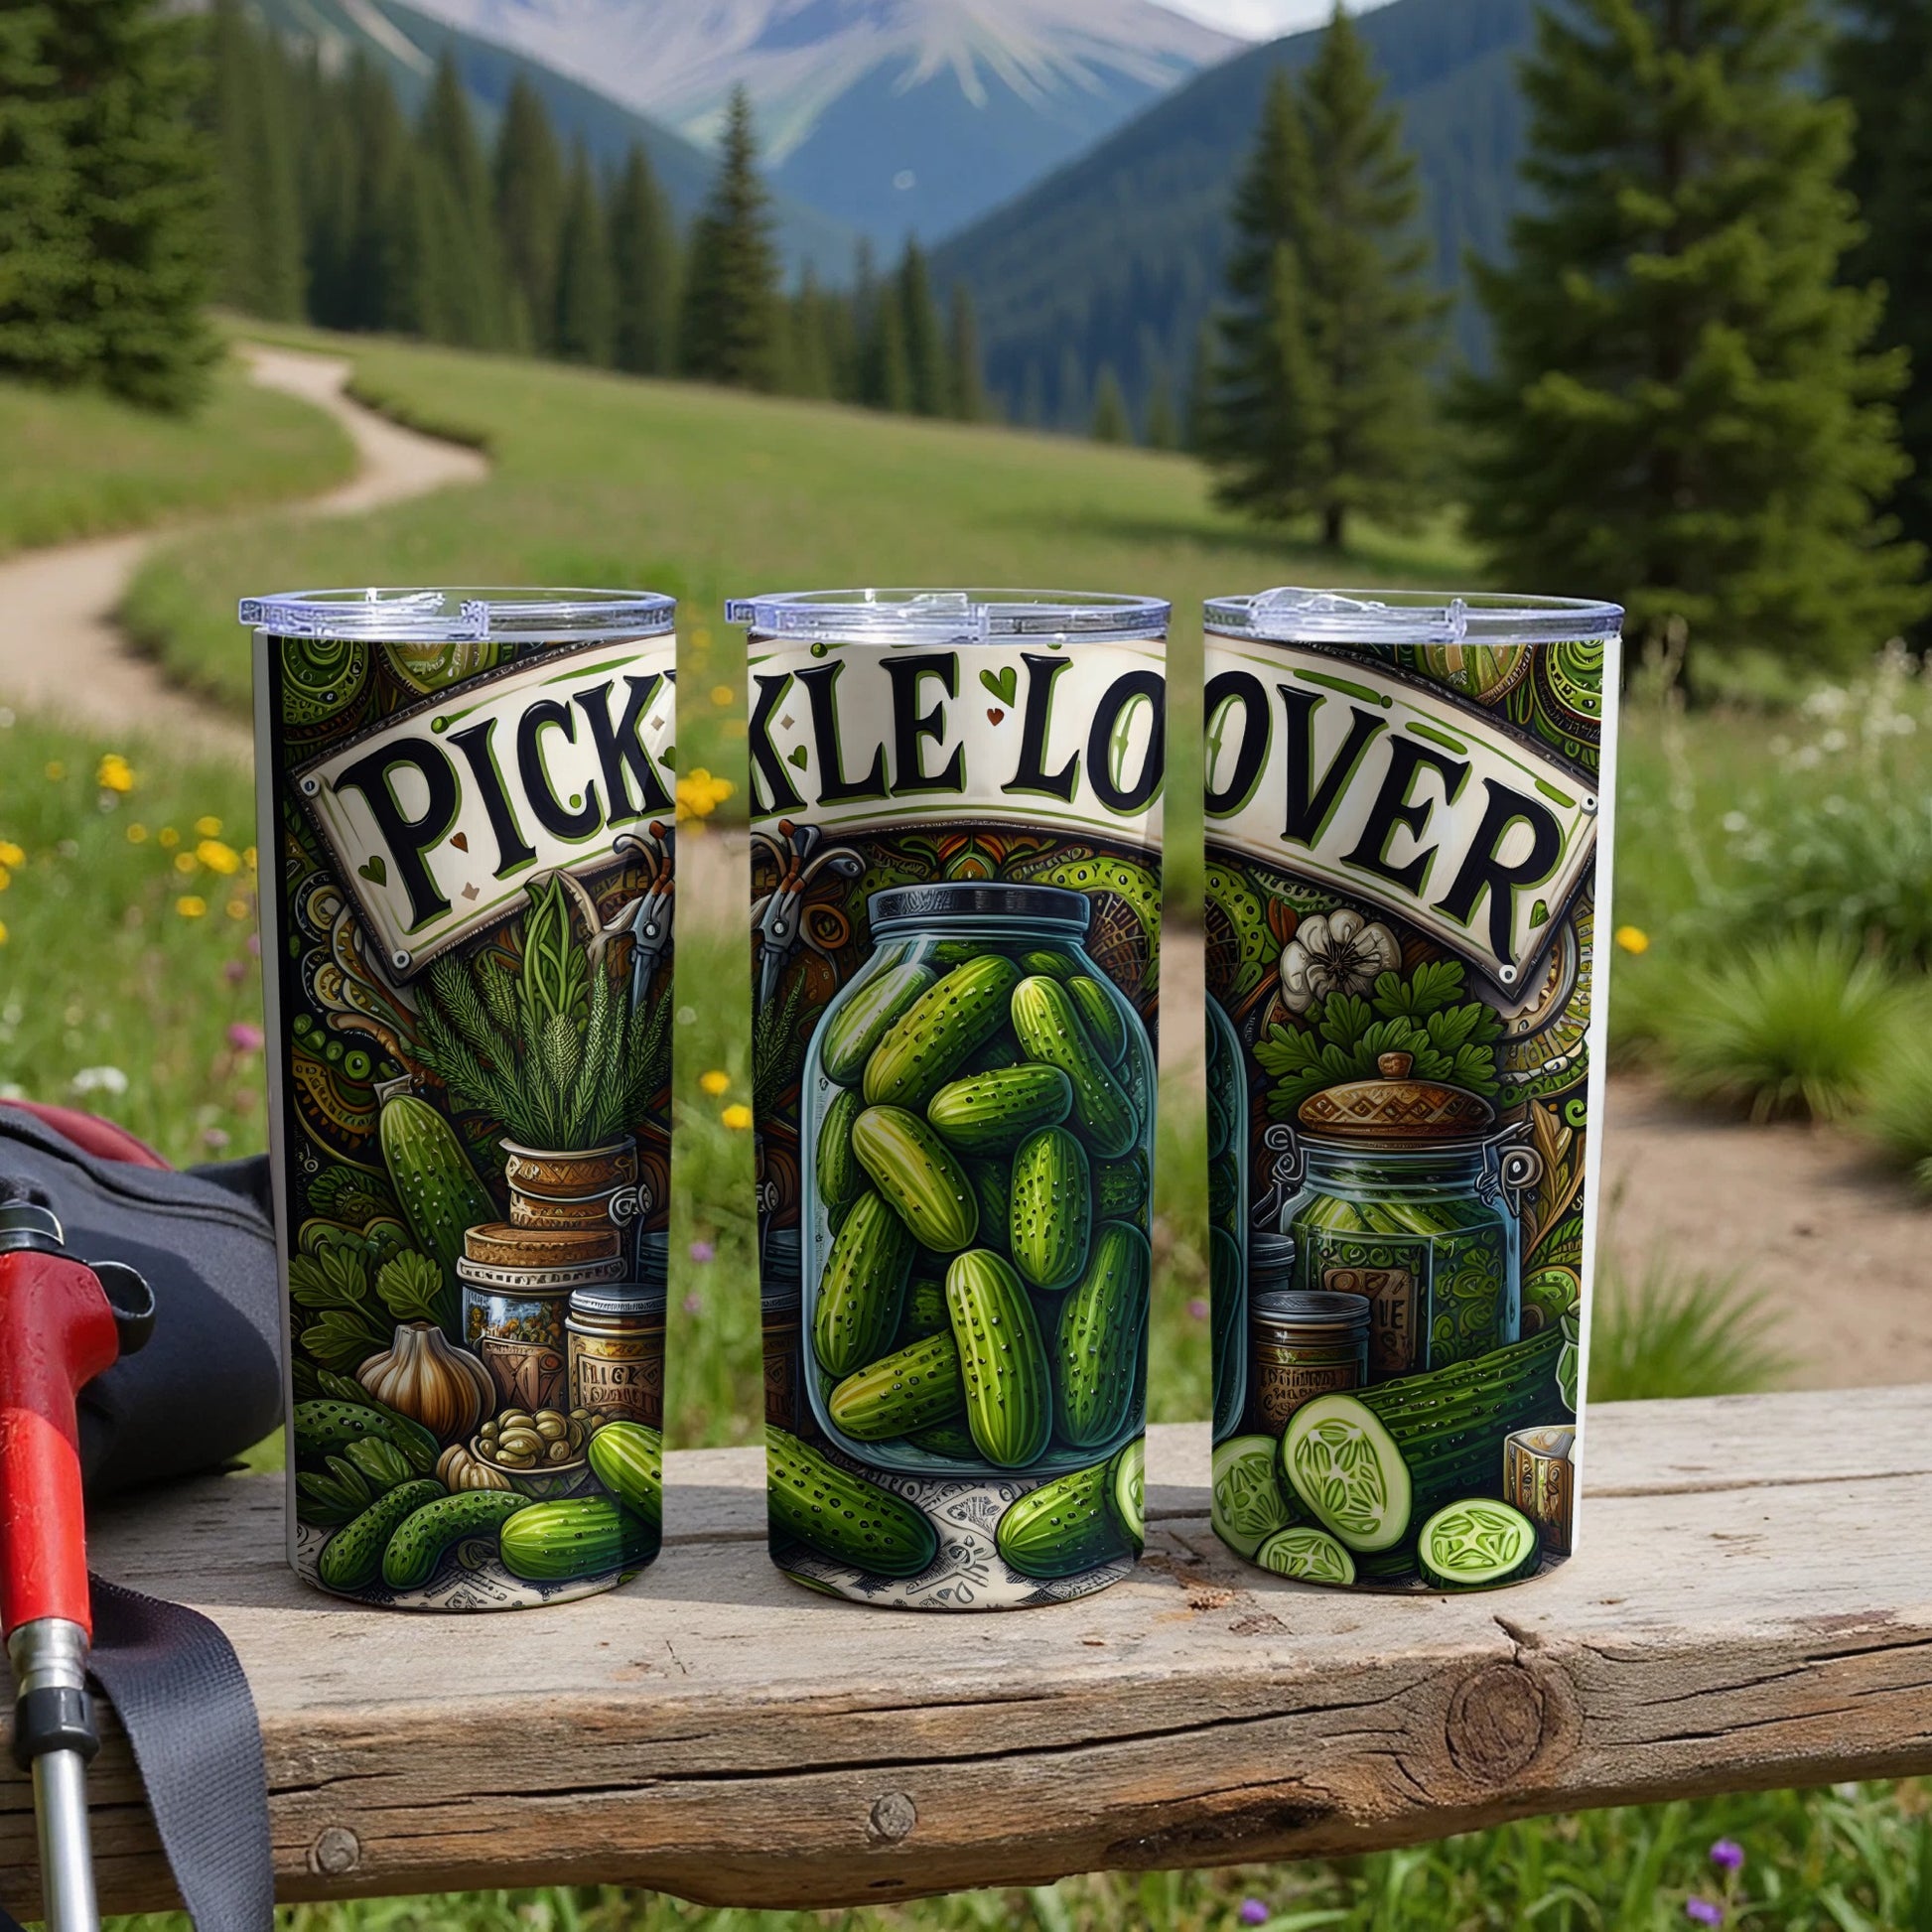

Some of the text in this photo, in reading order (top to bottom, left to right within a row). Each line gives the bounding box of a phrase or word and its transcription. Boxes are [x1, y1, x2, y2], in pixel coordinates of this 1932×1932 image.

[334, 673, 675, 935] PICK
[1001, 651, 1166, 817] LO
[1204, 671, 1567, 967] OVER
